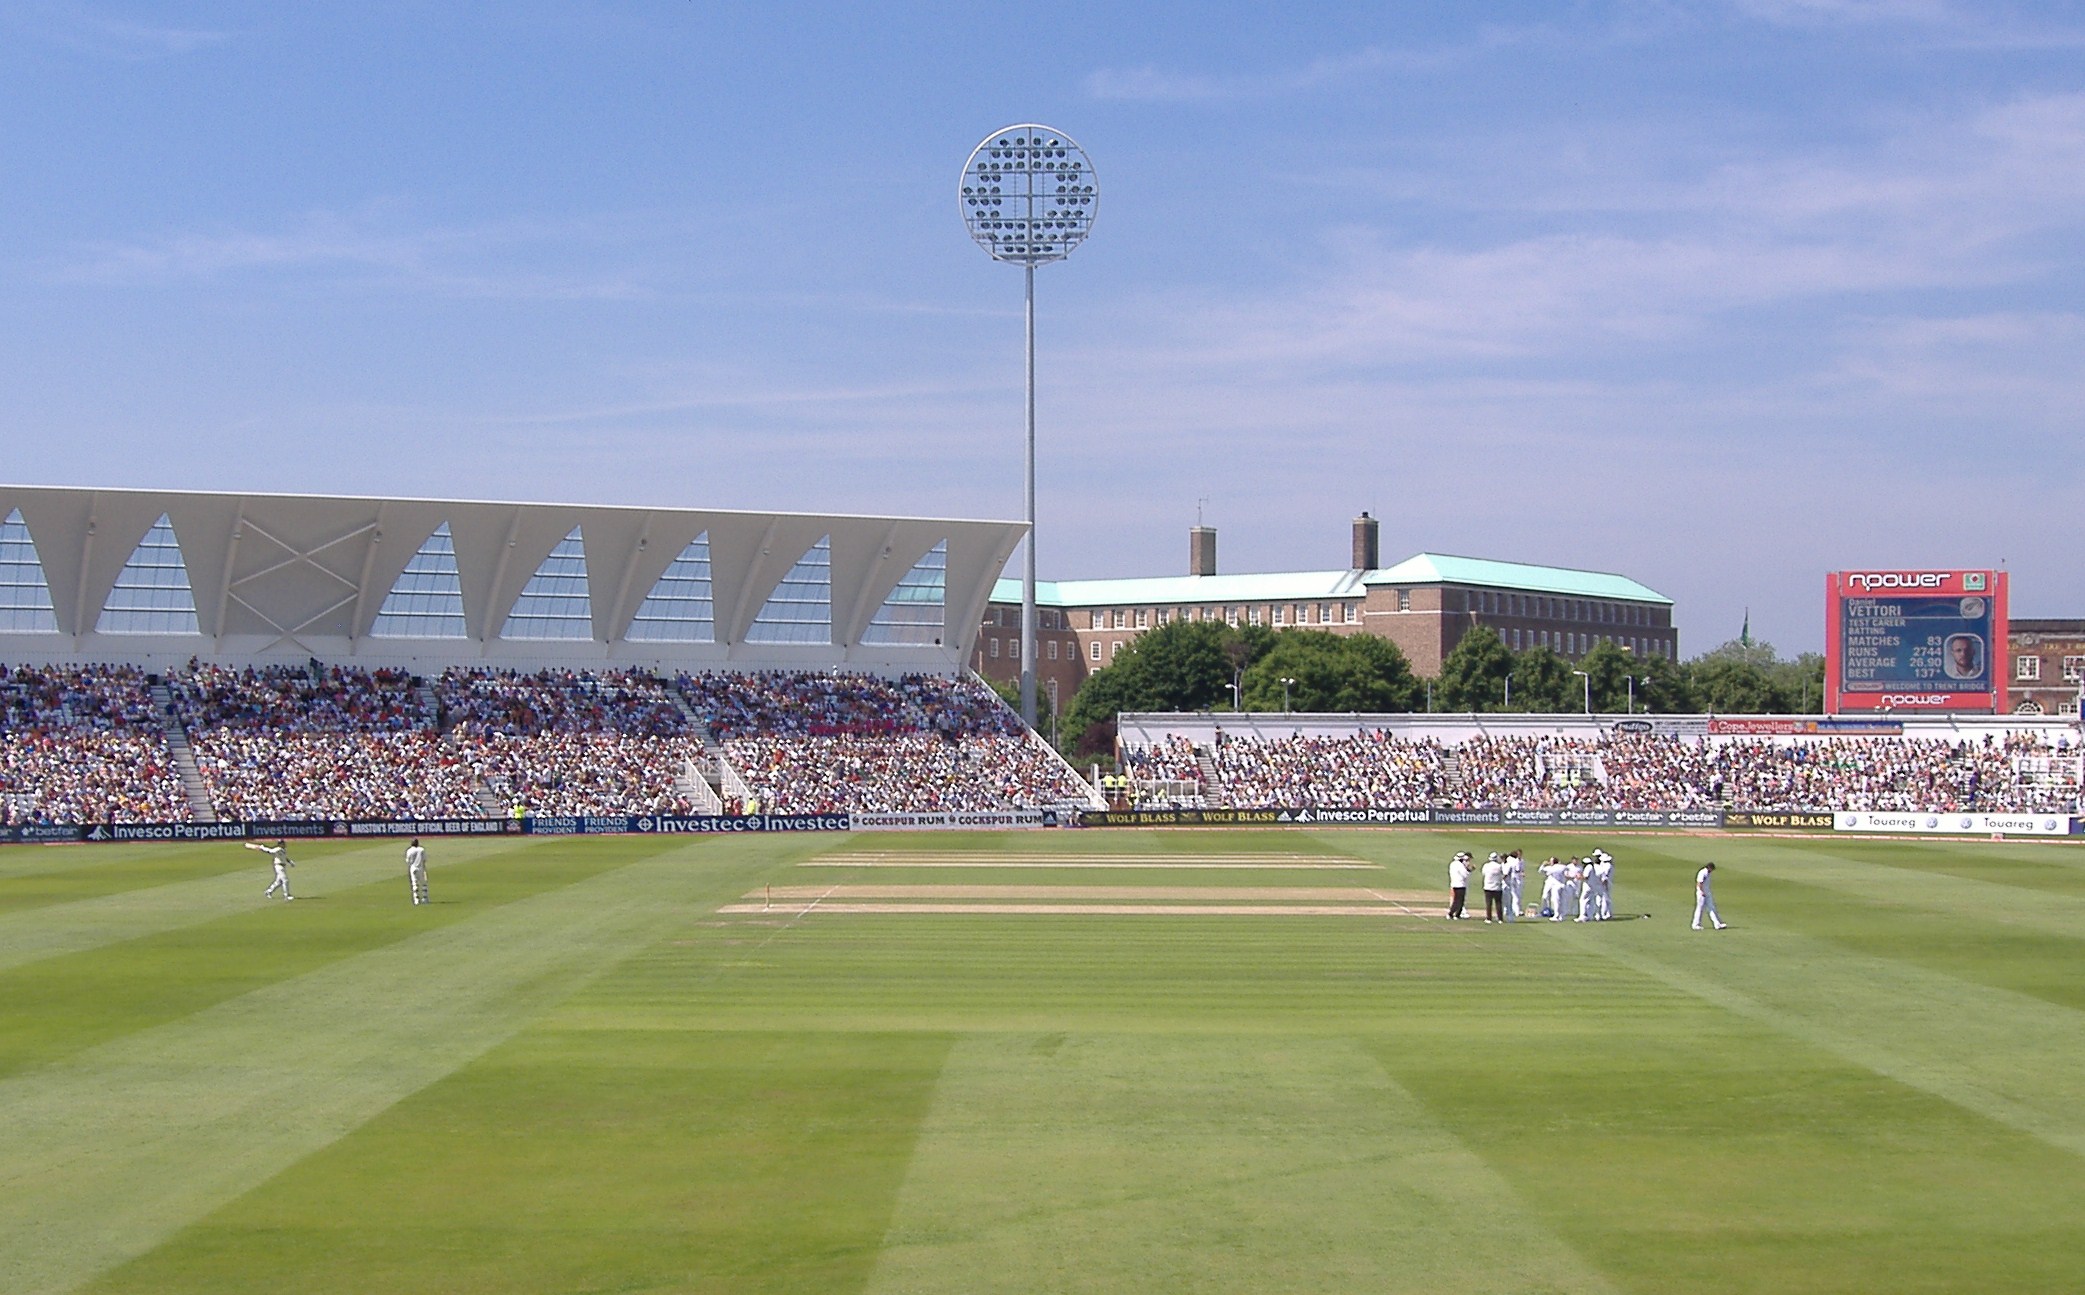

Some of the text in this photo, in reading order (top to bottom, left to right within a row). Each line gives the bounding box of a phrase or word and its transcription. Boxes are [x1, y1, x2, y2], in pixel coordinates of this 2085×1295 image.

[1849, 573, 1951, 591] npower
[1848, 605, 1901, 617] VETTORI
[1849, 618, 1906, 627] TEST CAREER
[1848, 627, 1885, 635] BATTING
[1848, 636, 1942, 646] MATCHES 83
[1848, 647, 1942, 657] RUNS 2744
[1848, 657, 1942, 667] AVERAGE 26.90
[1848, 668, 1875, 678] BEST
[1881, 695, 1951, 707] npower
[958, 815, 1042, 825] COCKSPUR RUM
[1106, 813, 1176, 823] WOLF BLASS
[1202, 811, 1275, 822] WOLF BLASS
[1316, 808, 1429, 823] Invesco Perpetual
[1435, 811, 1499, 822] Investments
[1517, 810, 1553, 820] betfair
[1571, 811, 1608, 821] betfair
[1627, 811, 1663, 821] betfair
[1681, 811, 1718, 821] betfair
[1751, 814, 1788, 826] WOLF
[1790, 814, 1832, 826] BLASS
[532, 818, 577, 827] FRIENDS
[584, 817, 628, 826] FRIENDS
[656, 816, 744, 832] Investec
[764, 815, 849, 831] Investec
[862, 816, 945, 826] COCKSPUR RUM
[1868, 815, 1916, 828] Touareg
[1984, 817, 2033, 831] Touareg
[35, 826, 78, 836] betfair
[114, 823, 246, 839] Invesco Perpetual
[252, 824, 325, 835] Investments
[445, 822, 461, 832] BEER
[461, 821, 470, 832] OF
[532, 826, 577, 834] PROVIDENT
